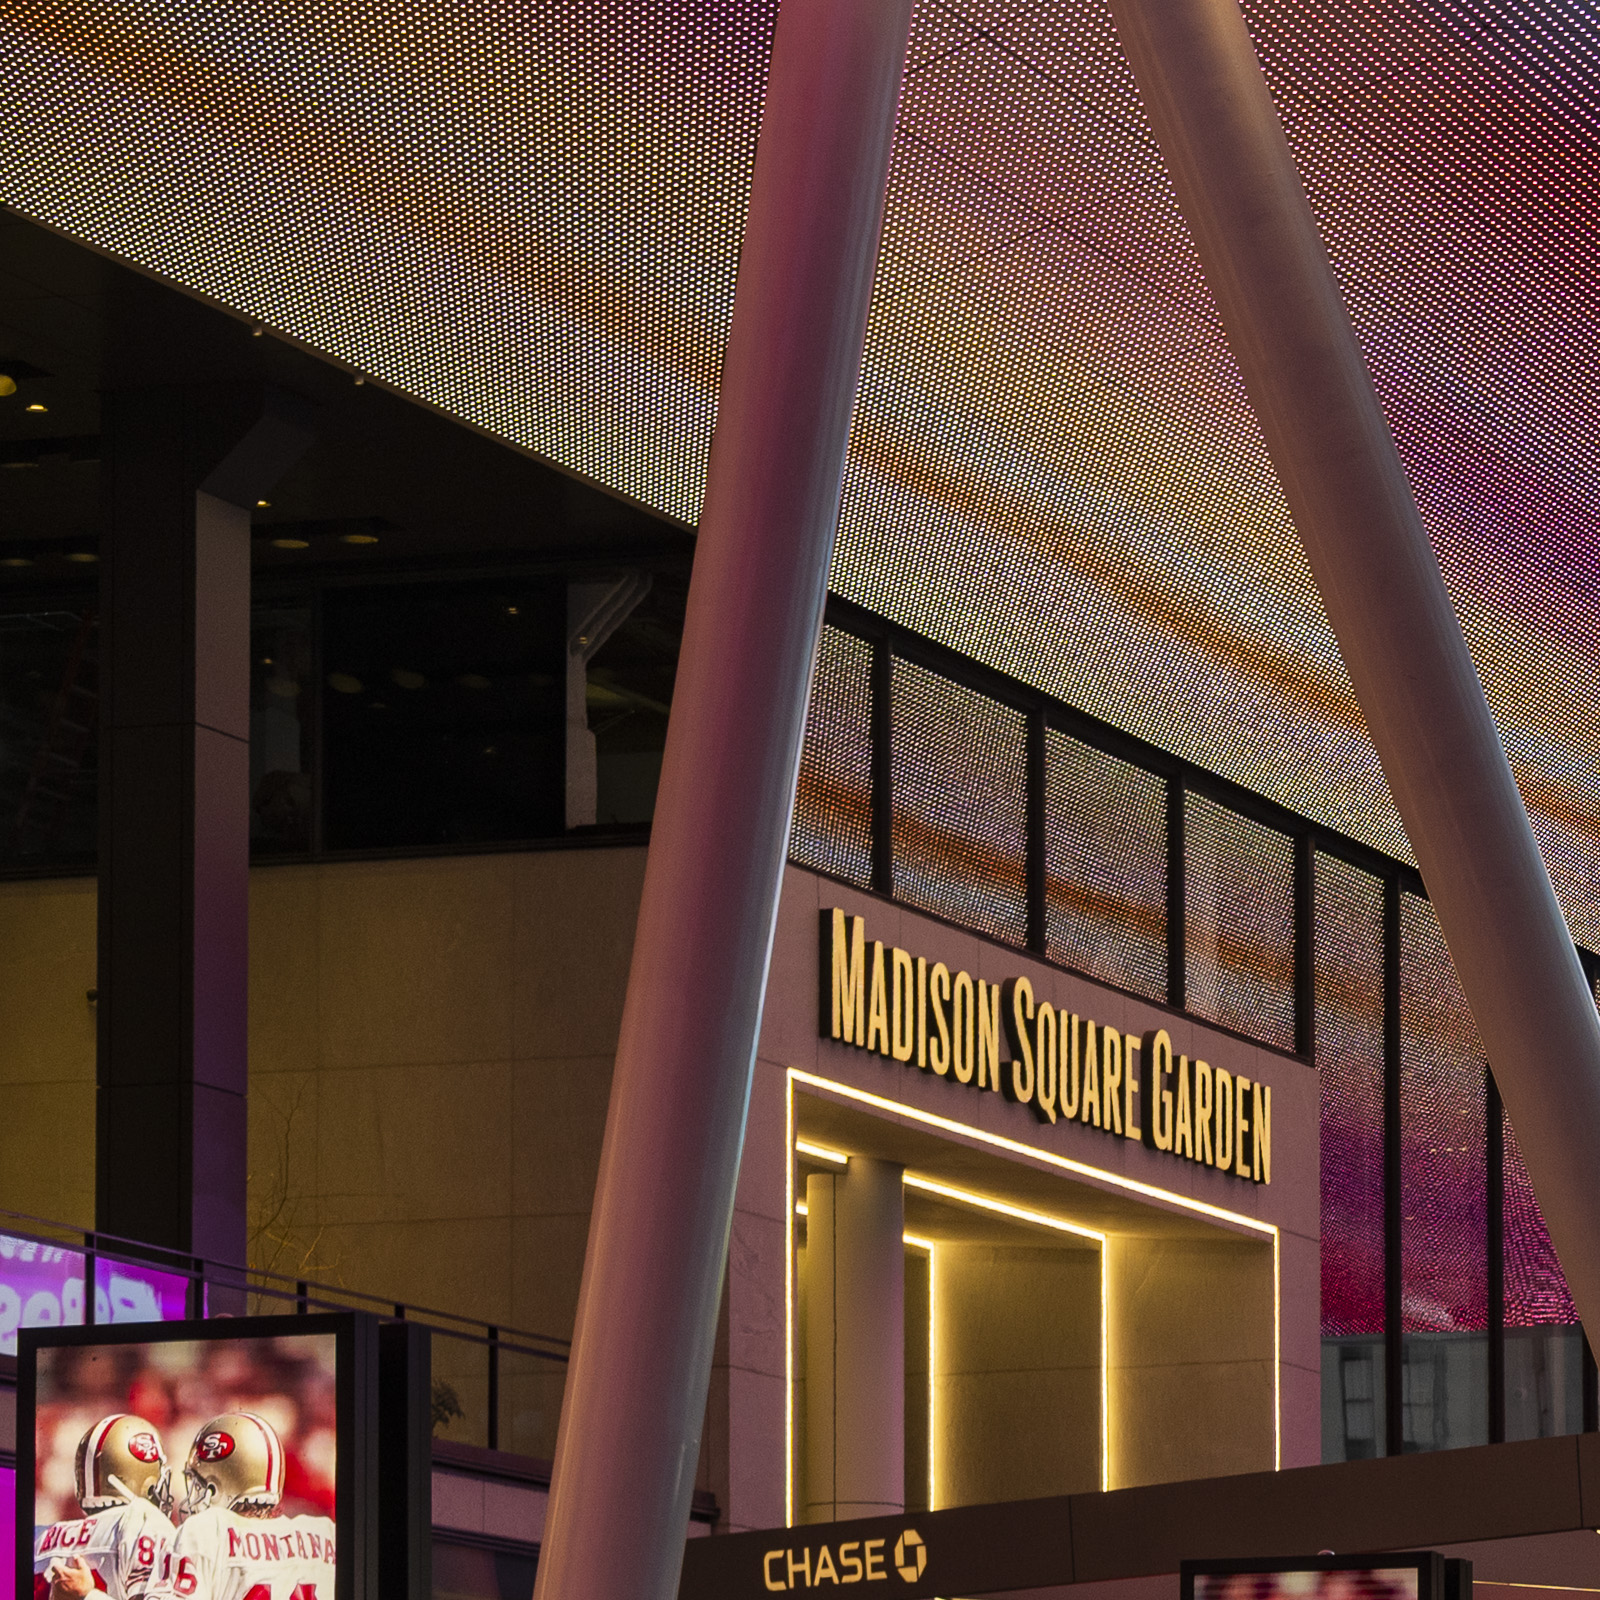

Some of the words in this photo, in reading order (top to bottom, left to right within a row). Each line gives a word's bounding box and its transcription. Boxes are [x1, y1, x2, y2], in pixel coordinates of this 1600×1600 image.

[829, 908, 1003, 1094] MADISON
[1011, 976, 1143, 1139] SQUARE
[1151, 1029, 1272, 1186] GARDEN
[40, 1518, 97, 1554] RICE
[227, 1526, 336, 1565] MONTANA
[763, 1538, 887, 1592] CHASE
